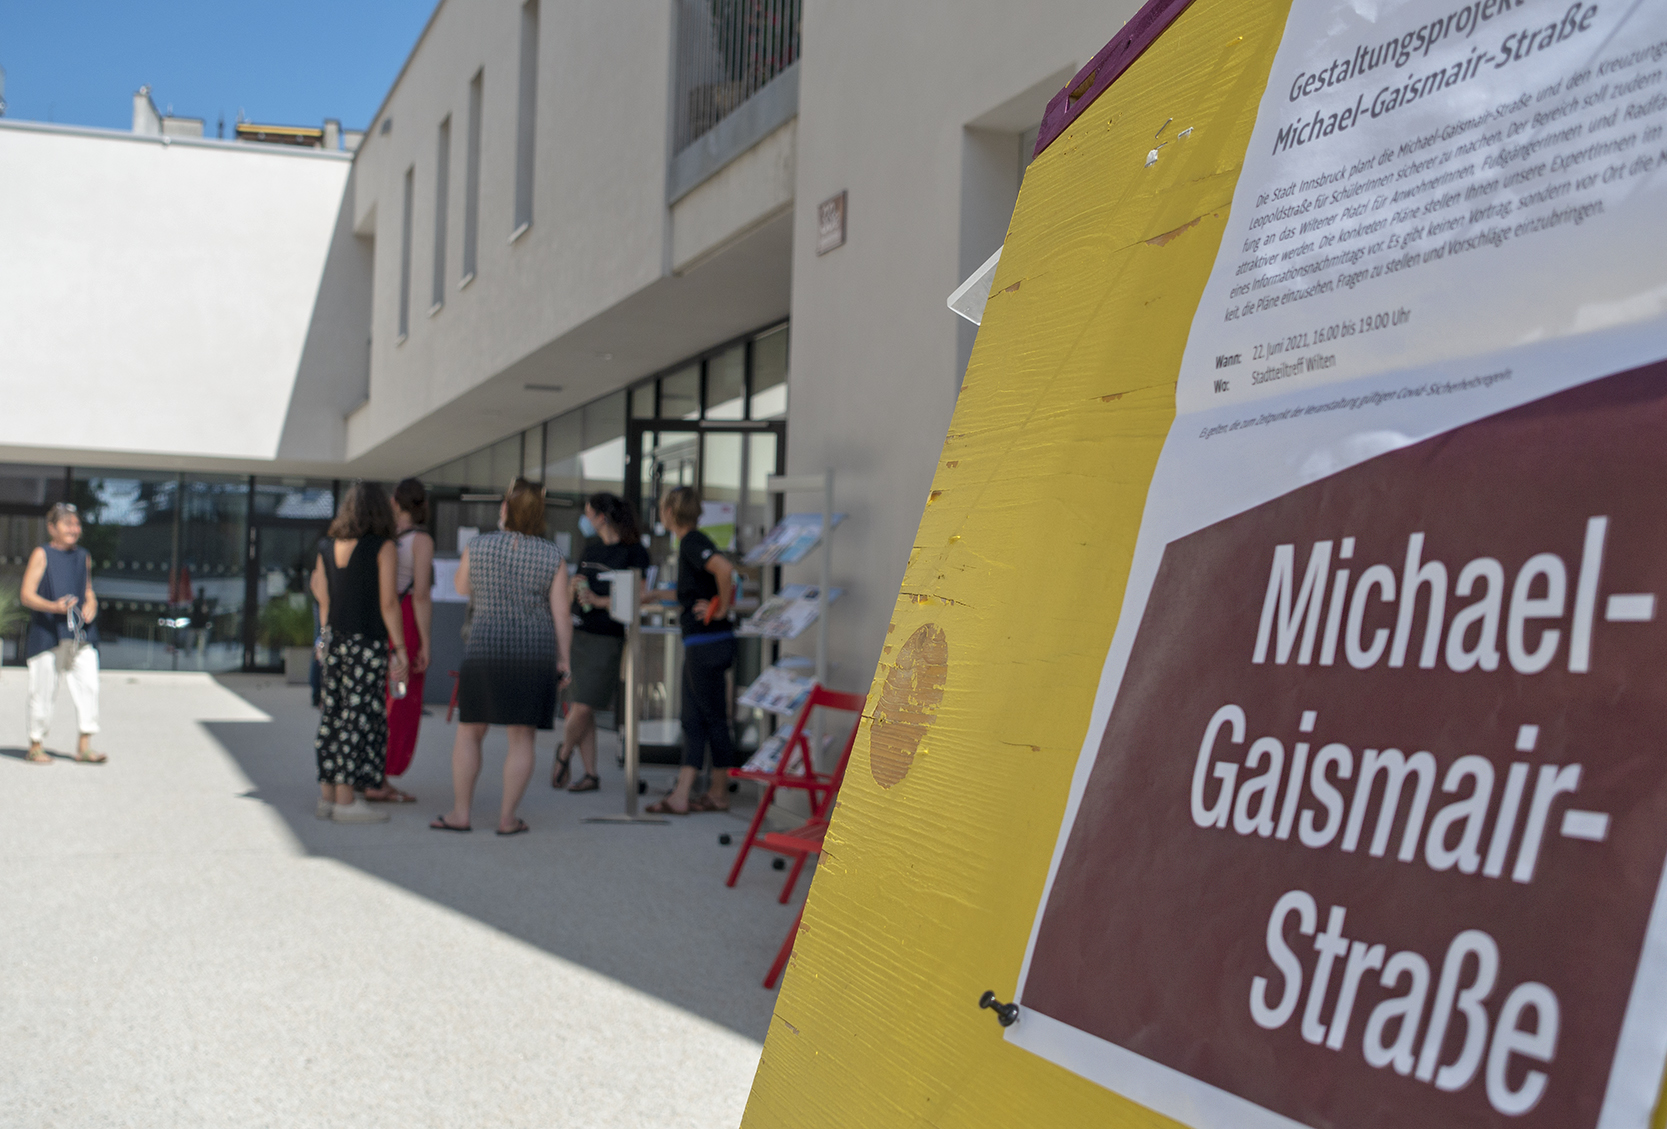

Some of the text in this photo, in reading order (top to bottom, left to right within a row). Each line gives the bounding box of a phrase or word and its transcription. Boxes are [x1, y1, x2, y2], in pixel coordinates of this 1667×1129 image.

[1272, 2, 1598, 156] Michael-Gaismair-Straße
[1289, 0, 1525, 103] Gestaltungsproje
[1235, 253, 1279, 276] attraktiver
[1318, 233, 1336, 249] Die
[1337, 218, 1388, 243] konkreten
[1390, 207, 1420, 226] Pläne
[1421, 191, 1461, 216] stellen
[1463, 179, 1499, 202] Ihnen
[1503, 163, 1546, 189] unsere
[1550, 132, 1637, 173] ExpertInnen
[1242, 238, 1261, 253] fung
[1263, 233, 1276, 246] an
[1279, 226, 1297, 242] das
[1299, 213, 1339, 236] Wiltener
[1340, 199, 1370, 221] Platzl
[1371, 195, 1389, 211] für
[1481, 124, 1582, 171] FußgängerInnen
[1588, 106, 1619, 134] und
[1249, 199, 1313, 231] Leopoldstraße
[1313, 193, 1330, 210] für
[1330, 173, 1394, 205] SchülerInnen
[1395, 156, 1438, 181] sicherer
[1438, 150, 1453, 165] zu
[1507, 120, 1530, 138] Der
[1531, 97, 1580, 129] Bereich
[1581, 83, 1609, 110] soll
[1610, 71, 1662, 99] zudem
[1255, 192, 1270, 208] Die
[1271, 182, 1297, 202] Stadt
[1299, 165, 1347, 193] Innsbruck
[1348, 155, 1376, 181] plant
[1377, 148, 1395, 166] die
[1397, 93, 1533, 158] Michael-Gaismair-Straße
[1536, 77, 1564, 102] und
[1566, 69, 1591, 90] den
[1229, 283, 1250, 299] eines
[1251, 247, 1366, 292] Informationsnachmittags
[1387, 233, 1401, 250] Es
[1400, 225, 1425, 250] gibt
[1426, 215, 1466, 238] keinen
[1517, 182, 1571, 210] sondern
[1575, 173, 1600, 192] vor
[1602, 162, 1627, 184] Ort
[1628, 154, 1654, 177] die
[1241, 301, 1255, 317] die
[1256, 295, 1280, 313] Pläne
[1336, 268, 1369, 290] Fragen
[1370, 265, 1383, 279] zu
[1384, 252, 1421, 275] stellen
[1422, 241, 1447, 263] und
[1447, 226, 1513, 256] Vorschläge
[1213, 352, 1337, 394] Wo: Stadtteiltreff Wilten
[1215, 306, 1412, 370] Wann: 22. Juni 2021, 16.00 bis 19.00 Uhr
[1252, 515, 1655, 676] Michael-
[1191, 704, 1610, 884] Gaismair-
[1249, 889, 1561, 1117] Straße
